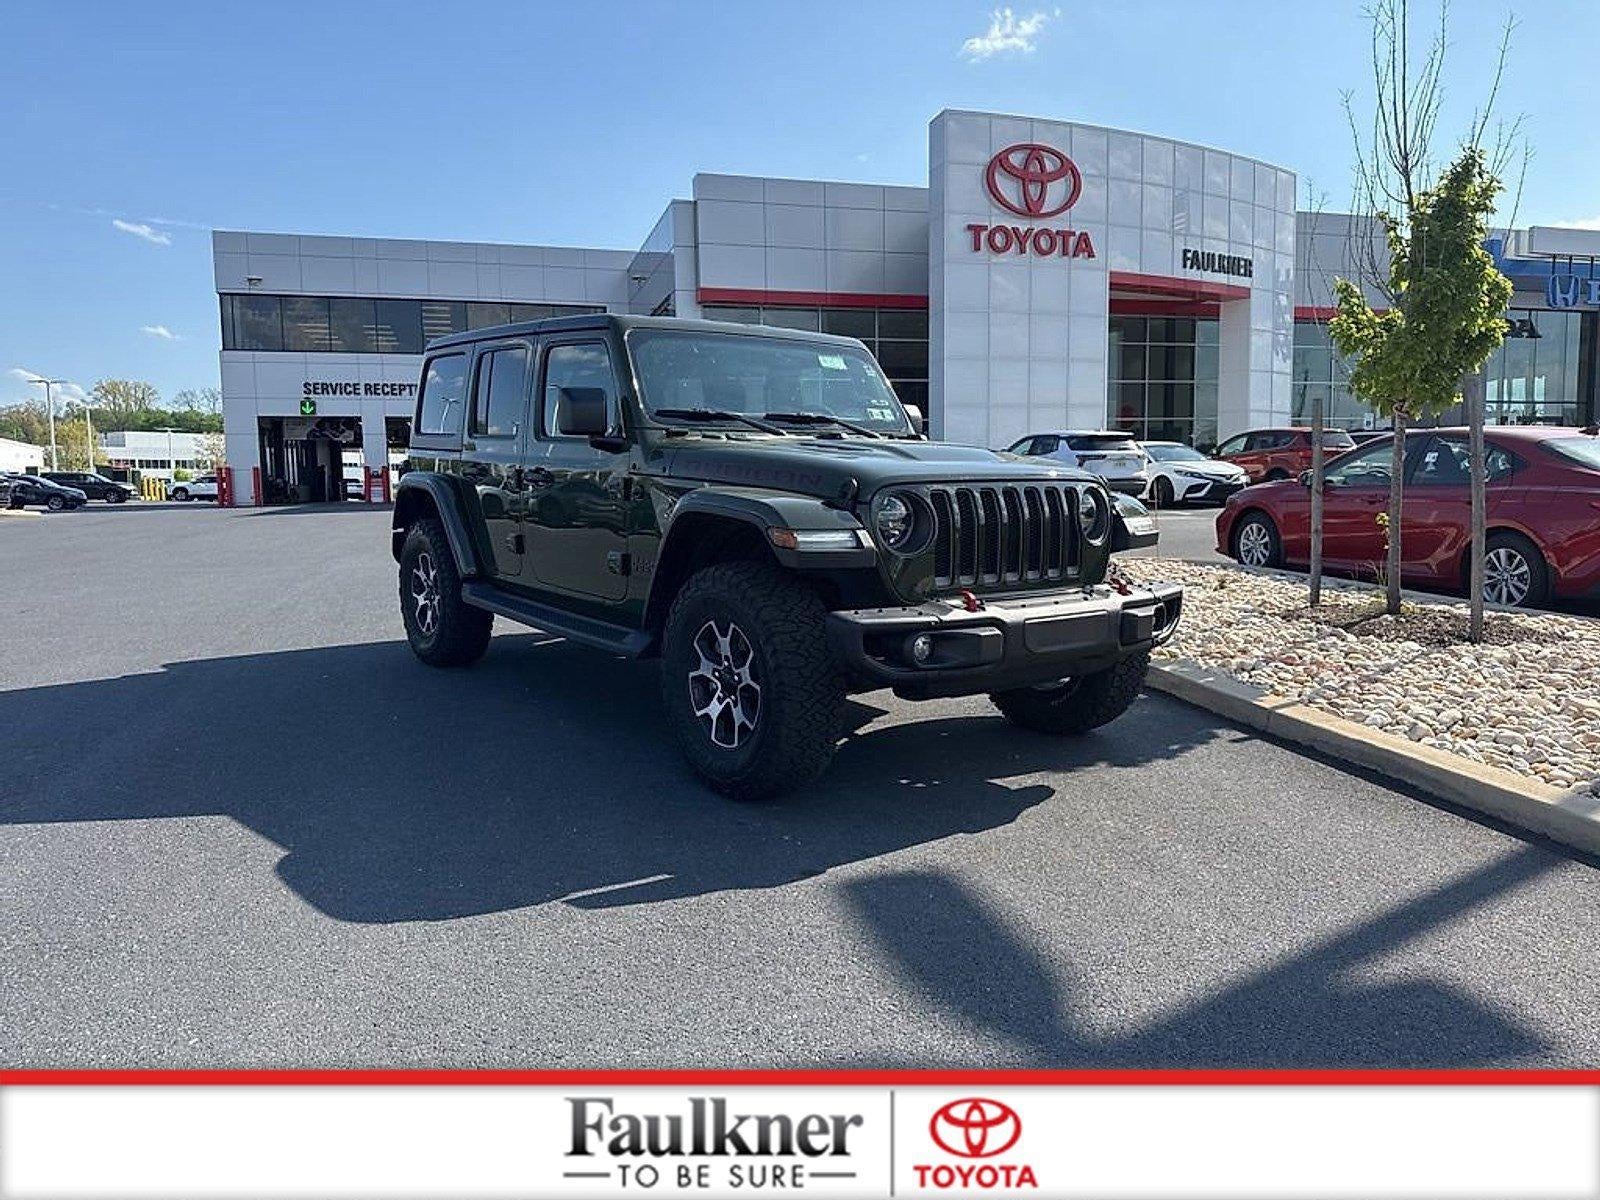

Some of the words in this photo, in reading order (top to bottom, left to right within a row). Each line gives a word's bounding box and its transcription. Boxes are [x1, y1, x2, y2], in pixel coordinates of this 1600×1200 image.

[966, 224, 1095, 258] TOYOTA
[1182, 248, 1253, 278] FAULKNER
[303, 382, 361, 396] SERVICE
